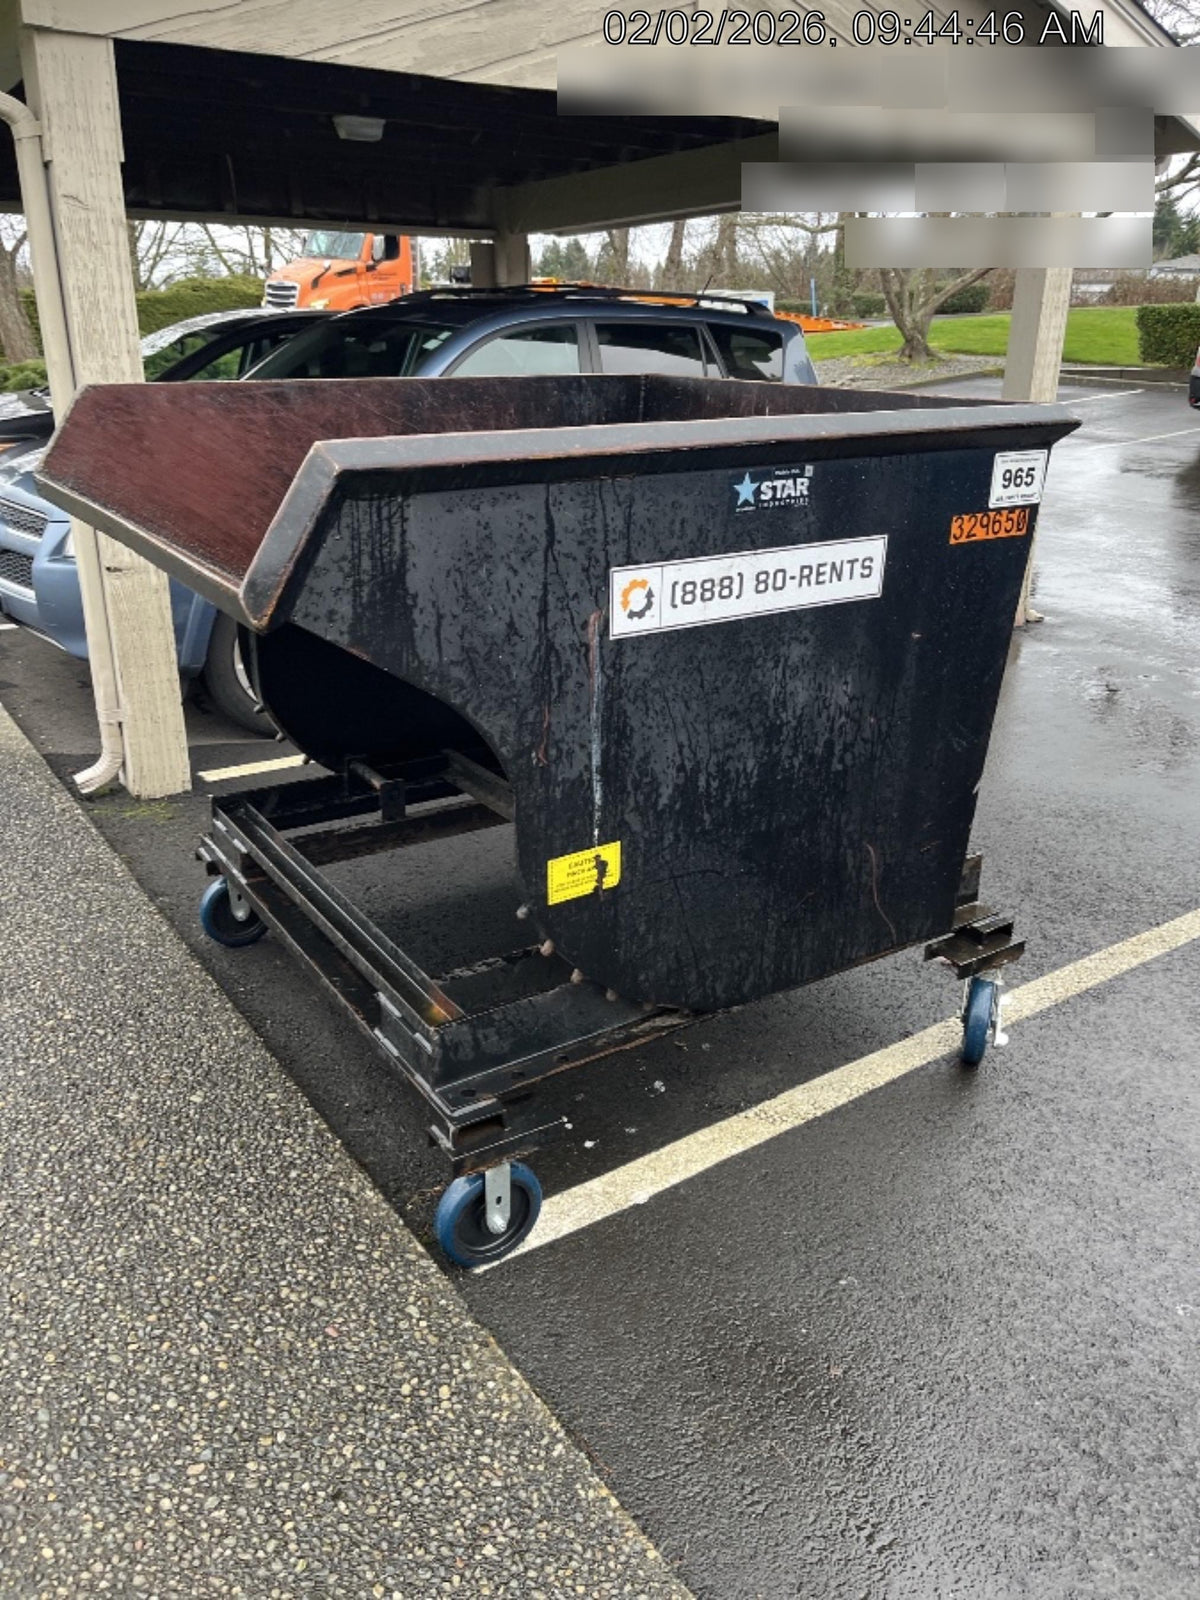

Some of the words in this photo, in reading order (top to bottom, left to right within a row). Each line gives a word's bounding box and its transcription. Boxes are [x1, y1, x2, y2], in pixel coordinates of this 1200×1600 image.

[760, 478, 810, 501] STAR
[1002, 467, 1036, 490] 965
[952, 509, 1027, 541] 329650
[670, 572, 744, 609] (888)
[754, 556, 874, 594] 80-RENTS
